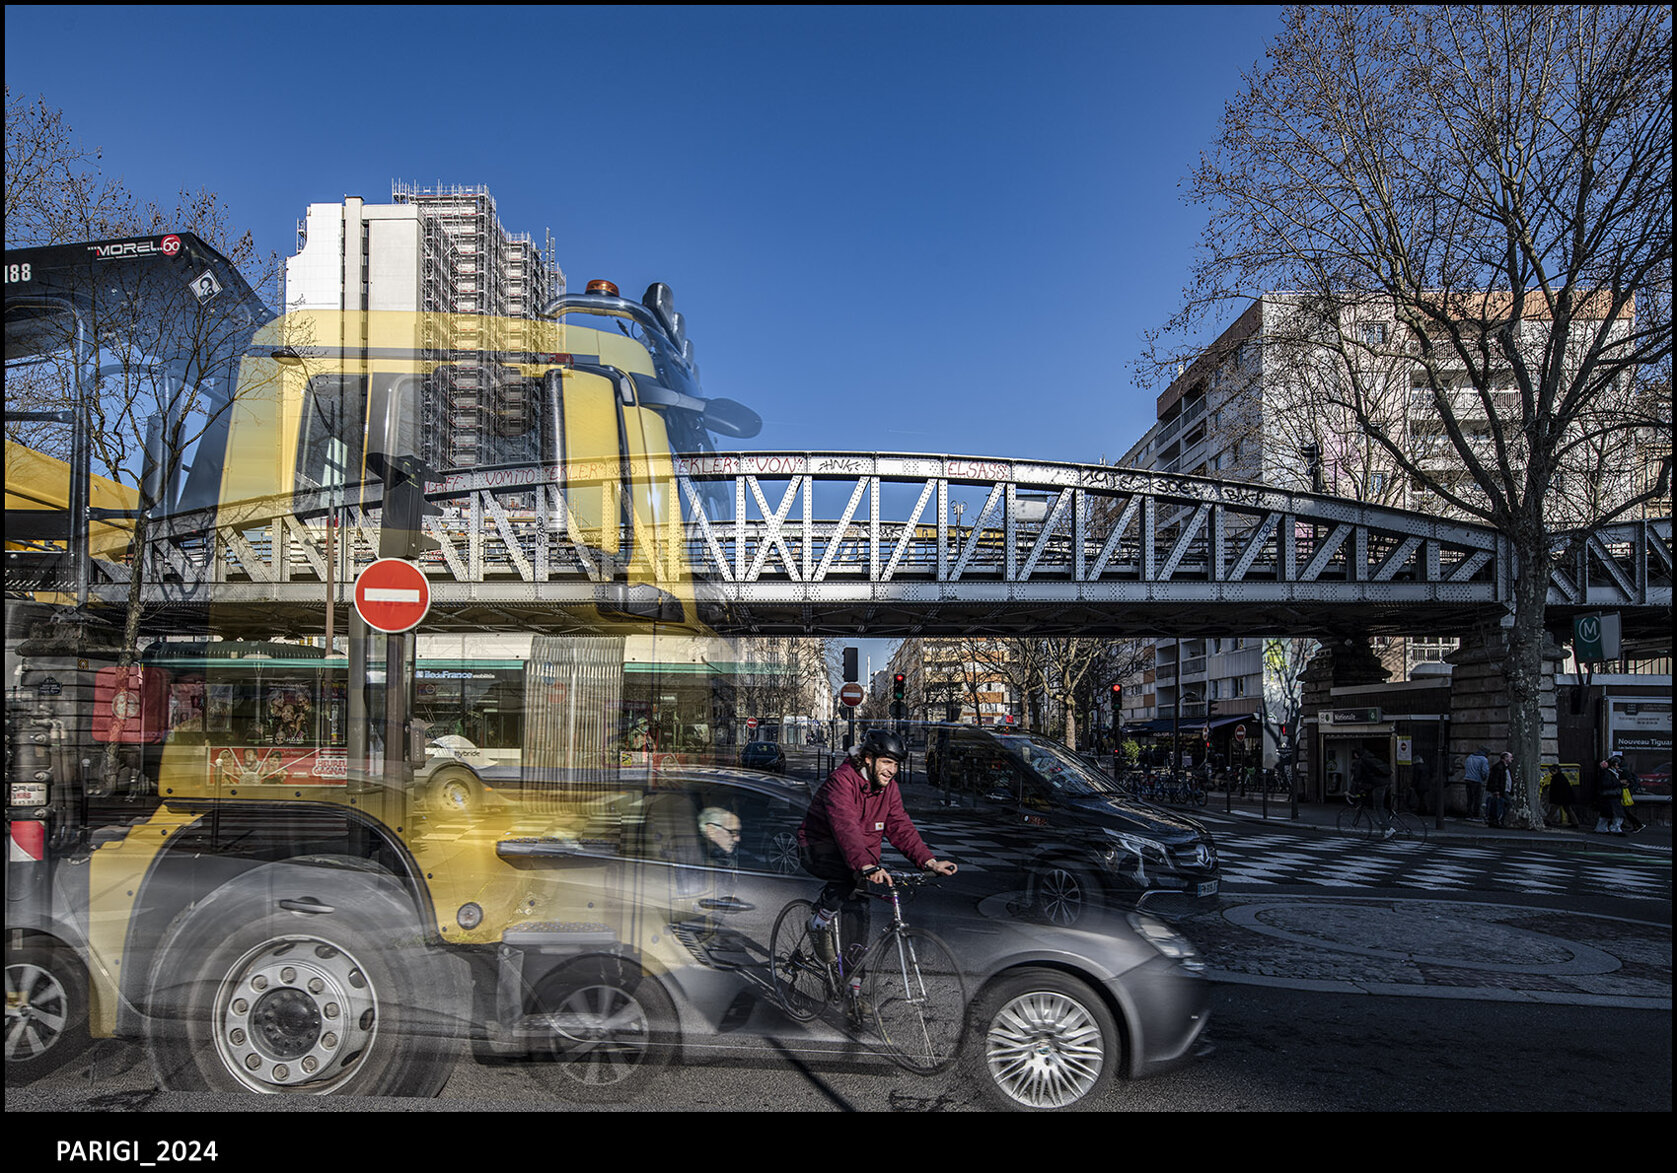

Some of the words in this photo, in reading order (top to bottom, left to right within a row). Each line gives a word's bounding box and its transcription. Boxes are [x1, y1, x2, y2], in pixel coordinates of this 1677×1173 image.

[96, 241, 158, 256] MOREL
[162, 238, 180, 252] 60
[1583, 621, 1597, 638] M
[1618, 738, 1650, 746] Nouveau
